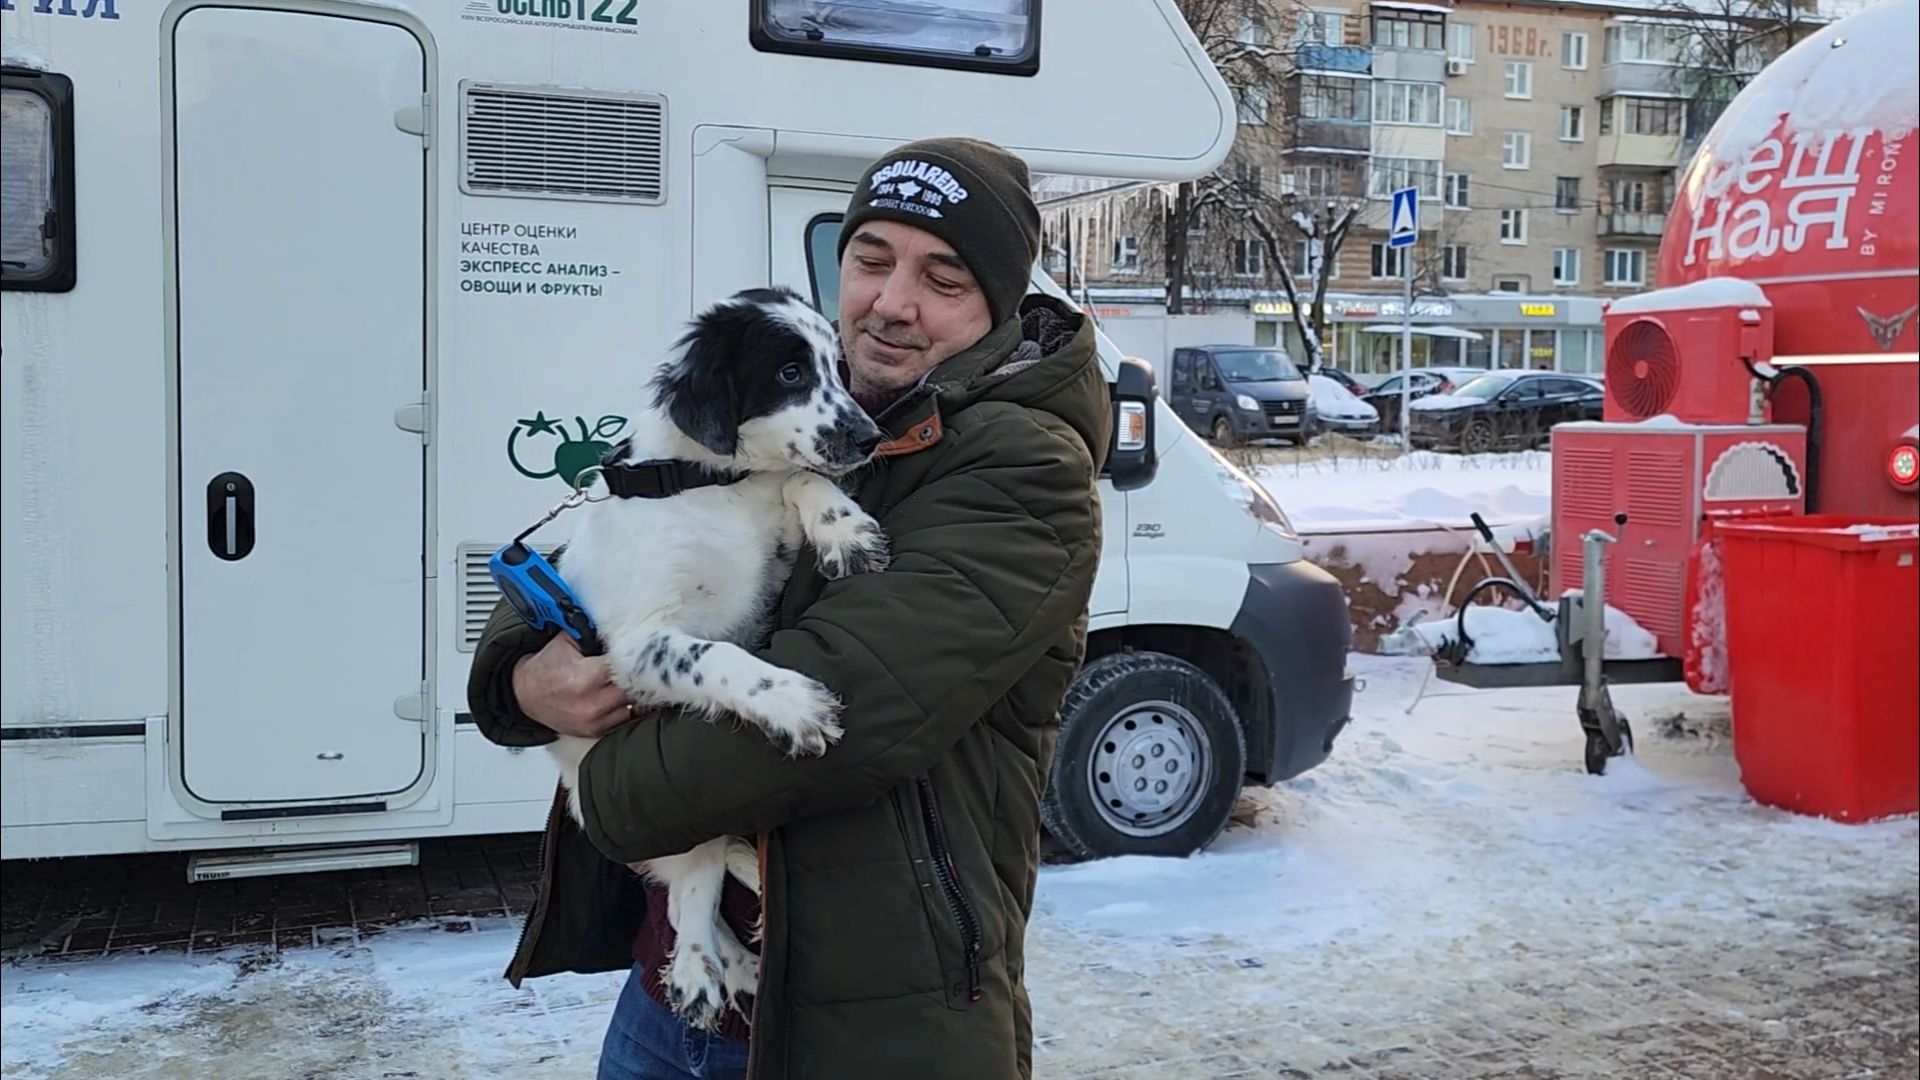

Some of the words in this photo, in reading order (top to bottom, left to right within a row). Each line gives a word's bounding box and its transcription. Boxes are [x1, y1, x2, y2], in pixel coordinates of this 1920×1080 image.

[460, 222, 510, 236] ЦЕНТР
[514, 224, 577, 239] ОЦЕНКИ
[461, 241, 540, 256] КАЧЕСТВА
[1860, 228, 1878, 256] BY
[460, 260, 542, 274] ЭКСПРЕСС
[546, 264, 608, 277] АНАЛИЗ
[460, 280, 522, 294] ОВОЩИ
[526, 282, 537, 294] И
[541, 283, 602, 296] ФРУКТЫ
